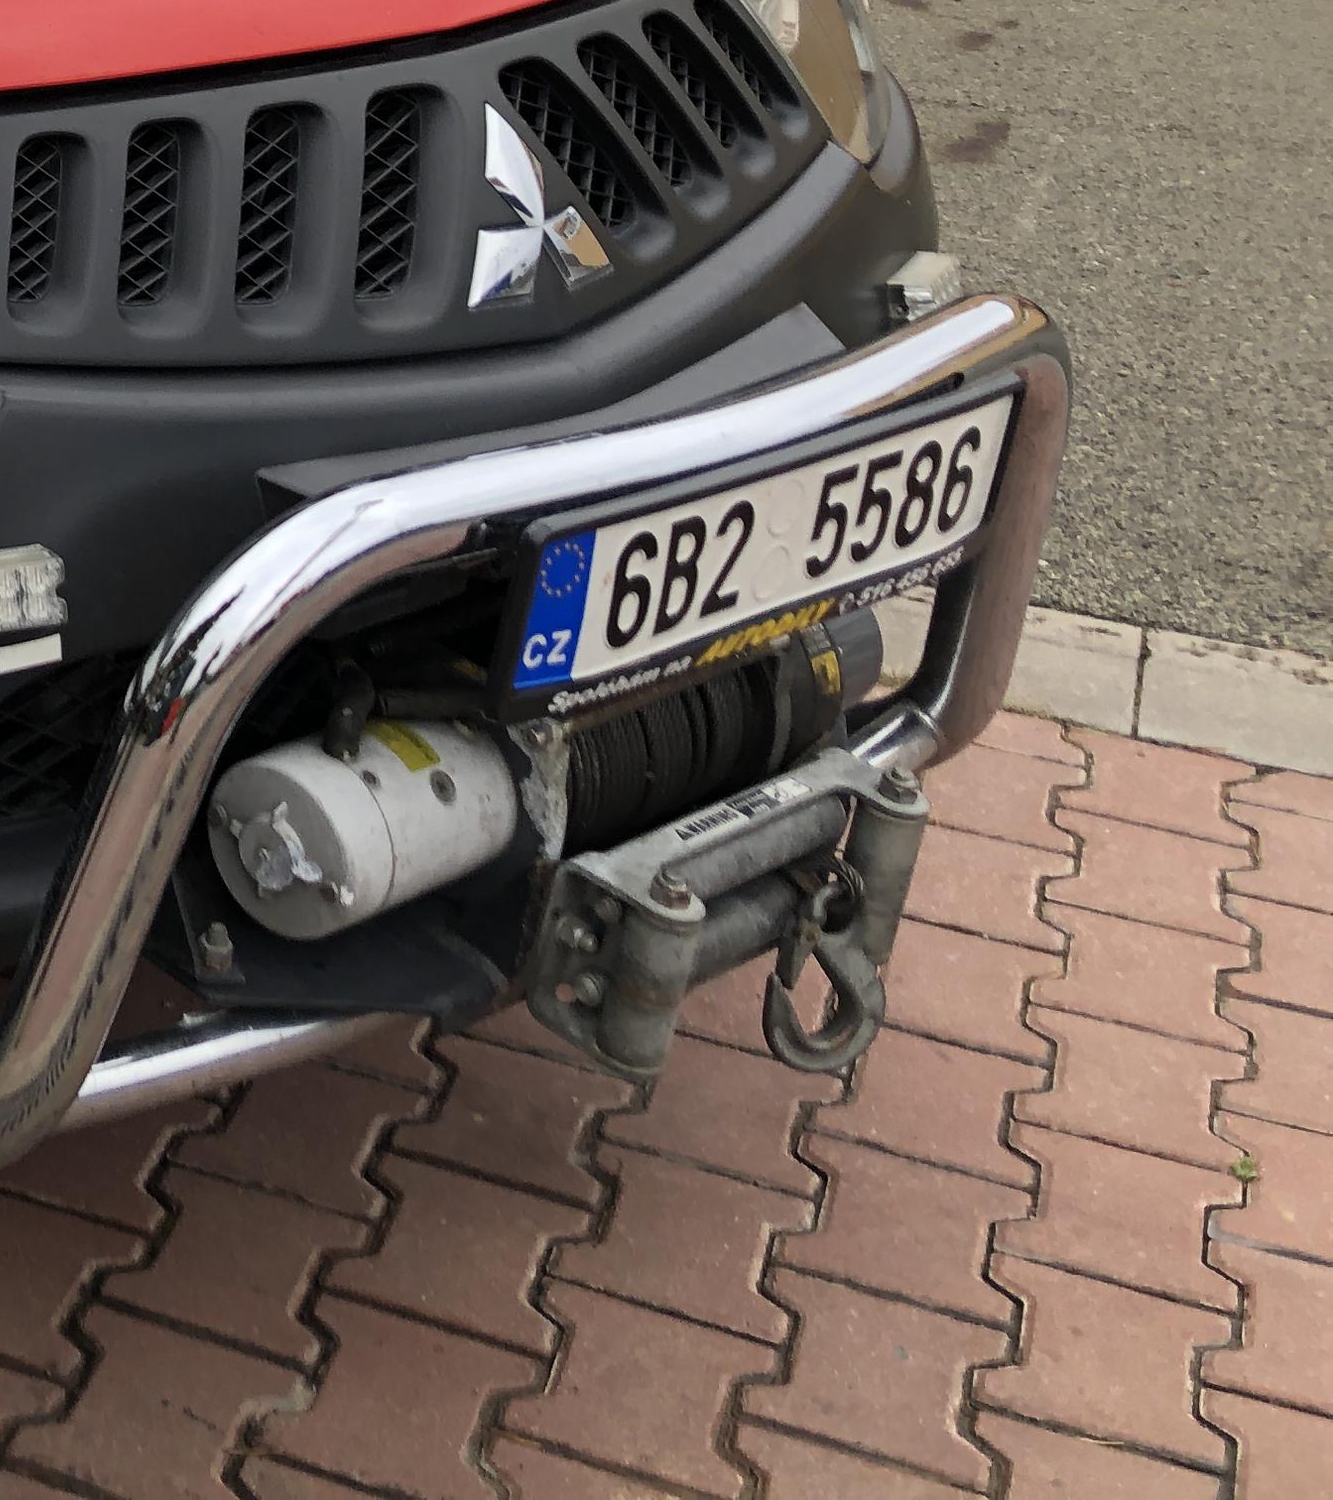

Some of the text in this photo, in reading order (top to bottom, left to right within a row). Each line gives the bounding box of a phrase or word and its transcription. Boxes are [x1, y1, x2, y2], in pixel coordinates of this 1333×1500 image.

[605, 499, 756, 649] 6B2
[805, 425, 982, 579] 5586
[521, 628, 573, 669] CZ
